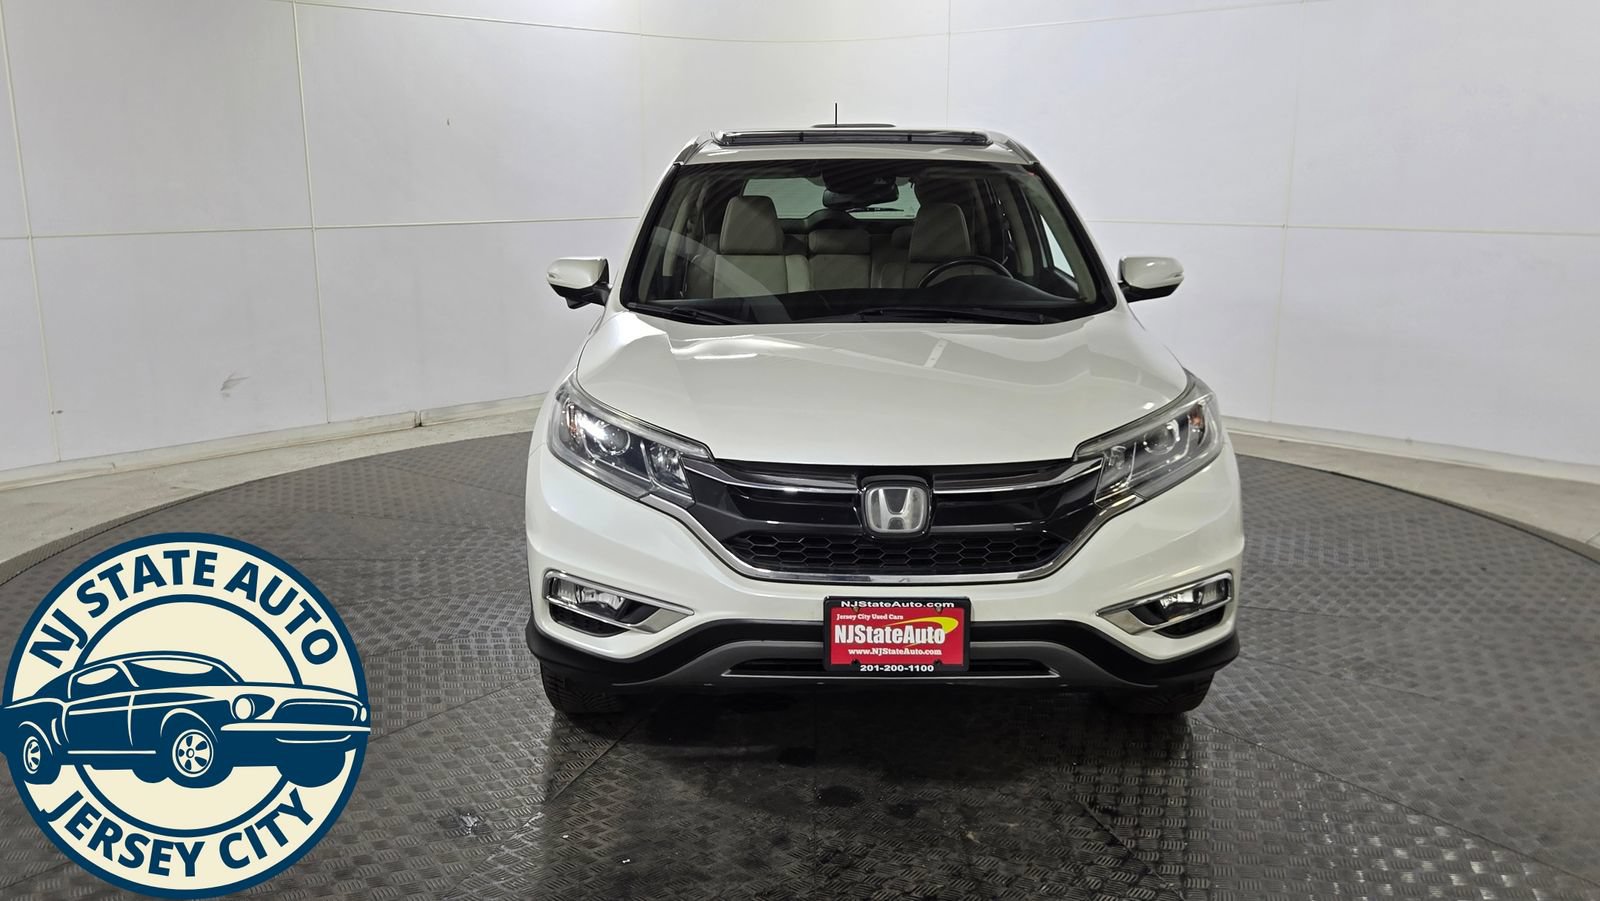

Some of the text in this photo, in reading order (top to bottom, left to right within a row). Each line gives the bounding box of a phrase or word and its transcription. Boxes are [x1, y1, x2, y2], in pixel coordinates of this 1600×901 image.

[841, 600, 955, 608] NJStateAuto.com
[834, 624, 946, 644] NJStateAuto
[848, 647, 942, 656] www.NJStateAuto.com
